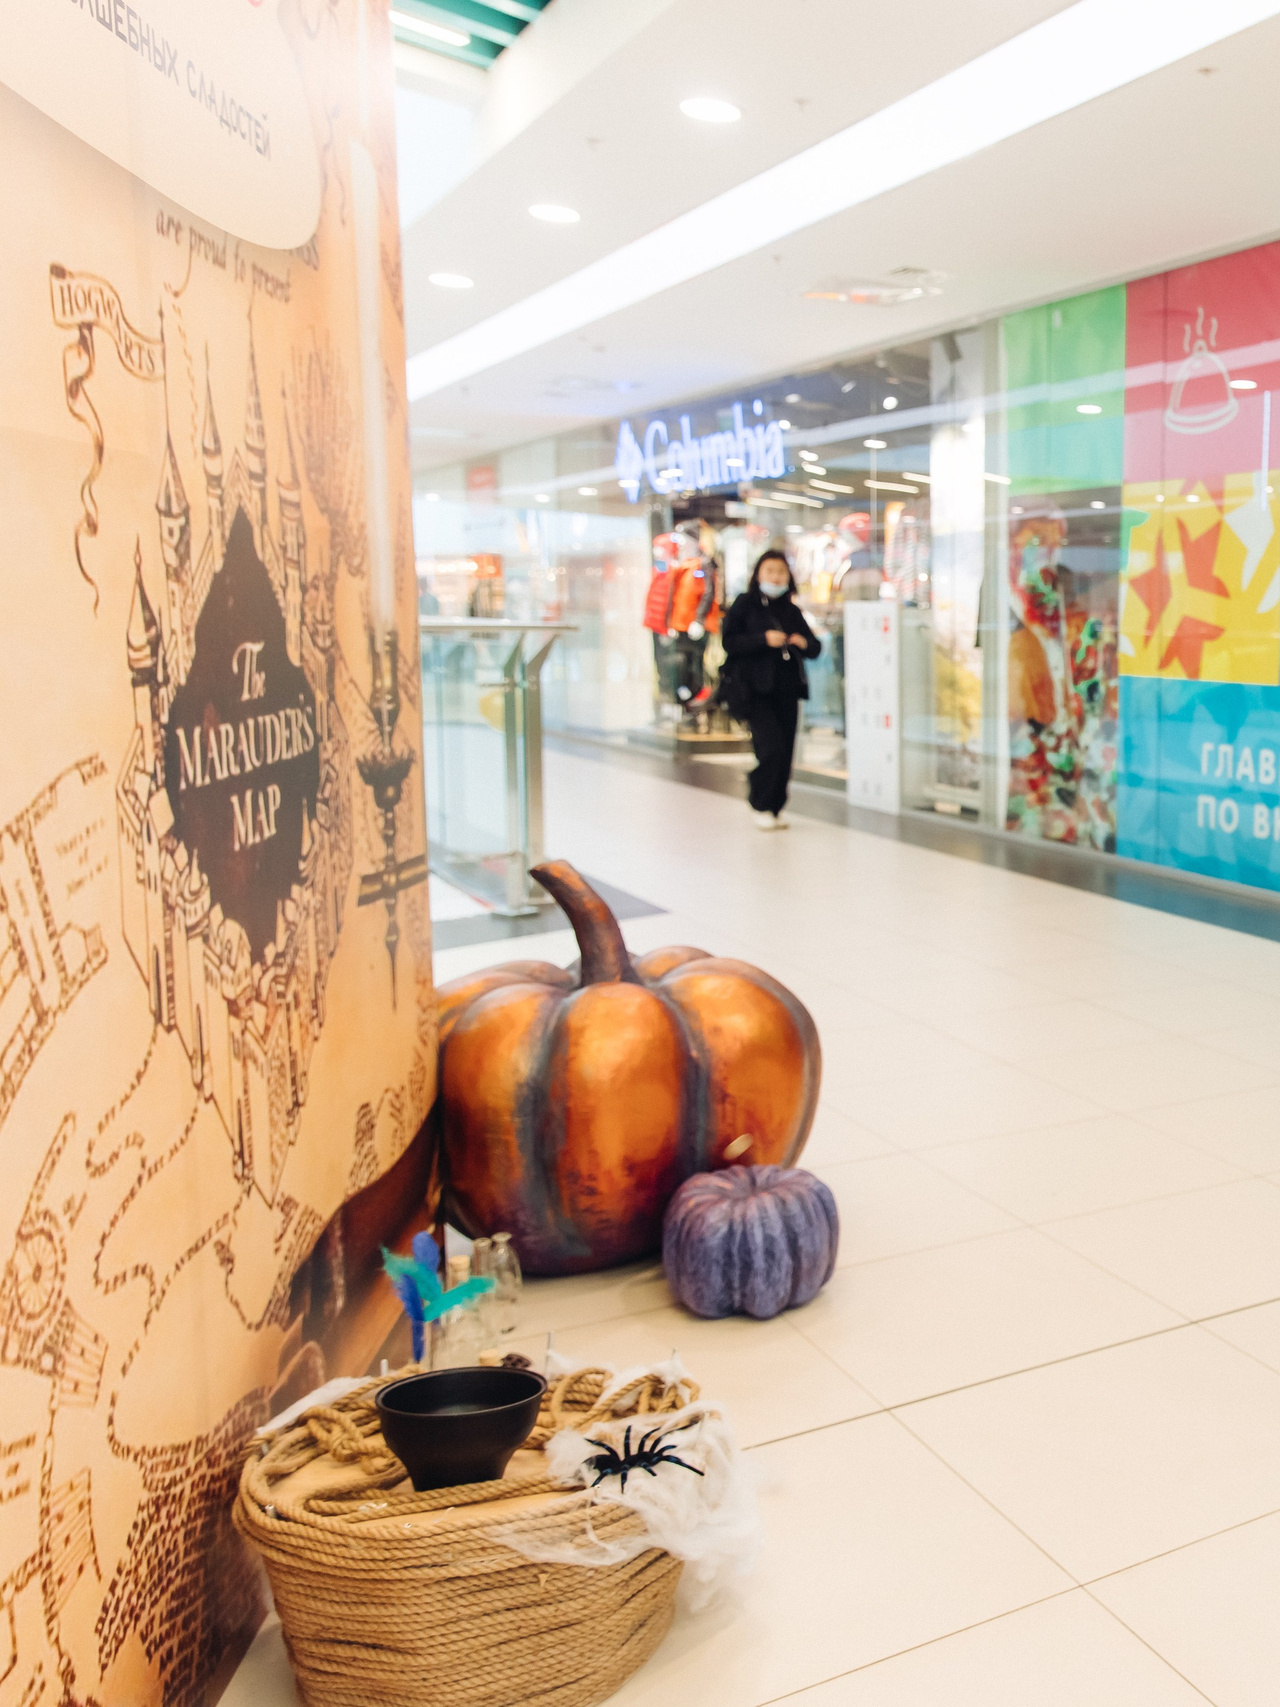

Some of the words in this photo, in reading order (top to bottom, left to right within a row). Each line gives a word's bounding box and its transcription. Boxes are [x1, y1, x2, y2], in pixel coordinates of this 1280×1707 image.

[71, 0, 180, 86] ШЕБНЫХ
[186, 59, 272, 162] СЛАДОСТЕЙ
[59, 283, 156, 376] HOGWARTS
[643, 398, 786, 495] Columbia
[232, 640, 266, 701] The
[230, 784, 281, 852] MAP
[1196, 793, 1240, 834] ПО
